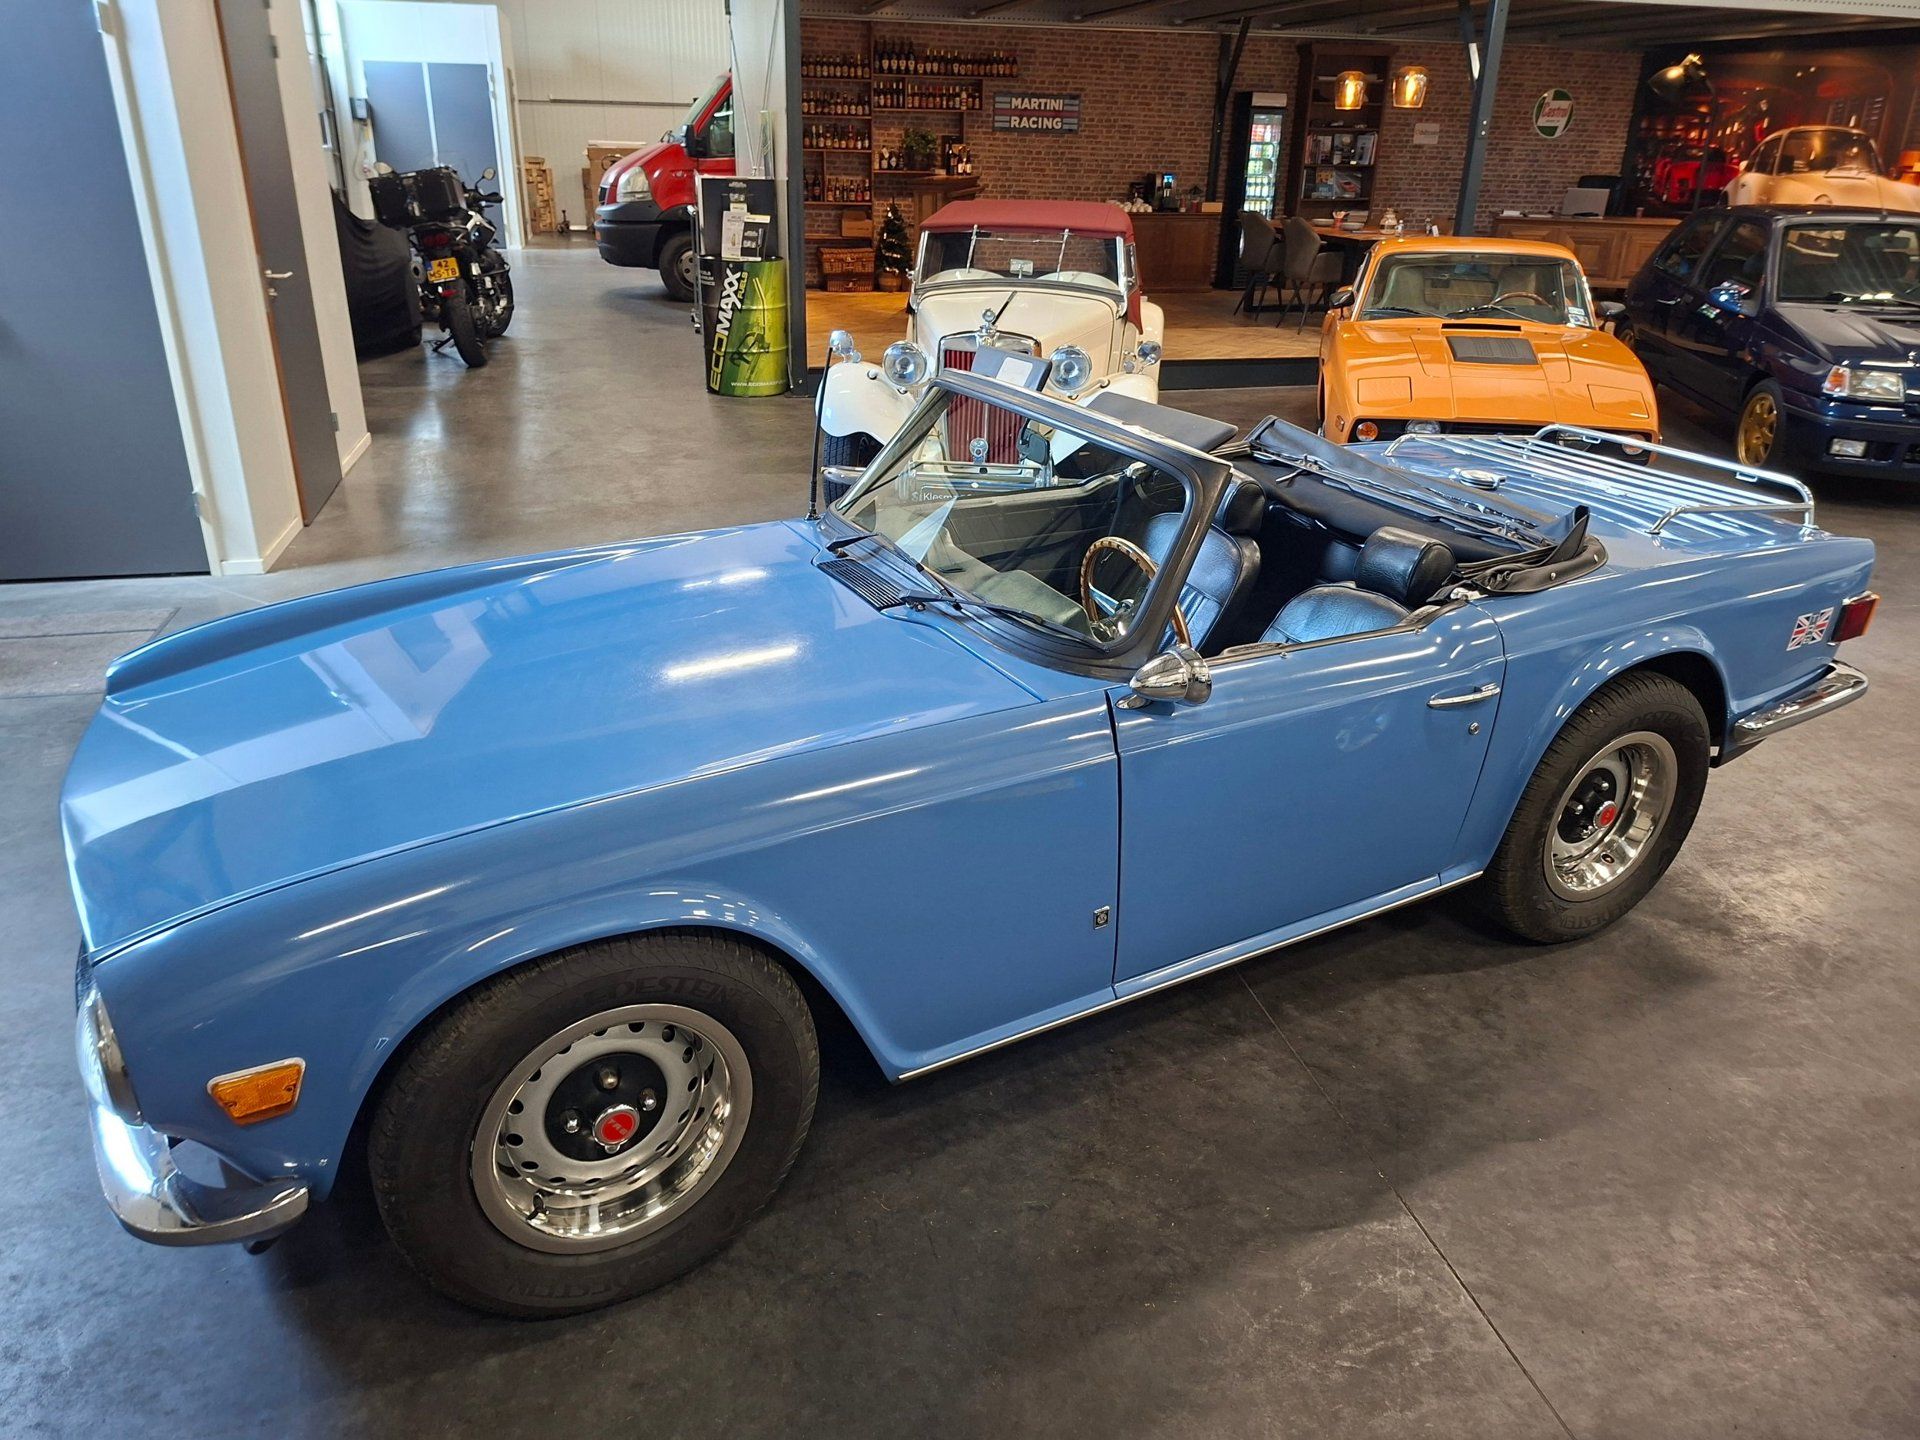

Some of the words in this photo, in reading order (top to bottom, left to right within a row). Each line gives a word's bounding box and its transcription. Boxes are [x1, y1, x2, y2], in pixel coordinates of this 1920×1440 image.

[1011, 97, 1064, 111] MARTINI
[1010, 116, 1062, 130] RACING
[738, 271, 749, 300] FUELS
[710, 267, 742, 391] ECOMAXX
